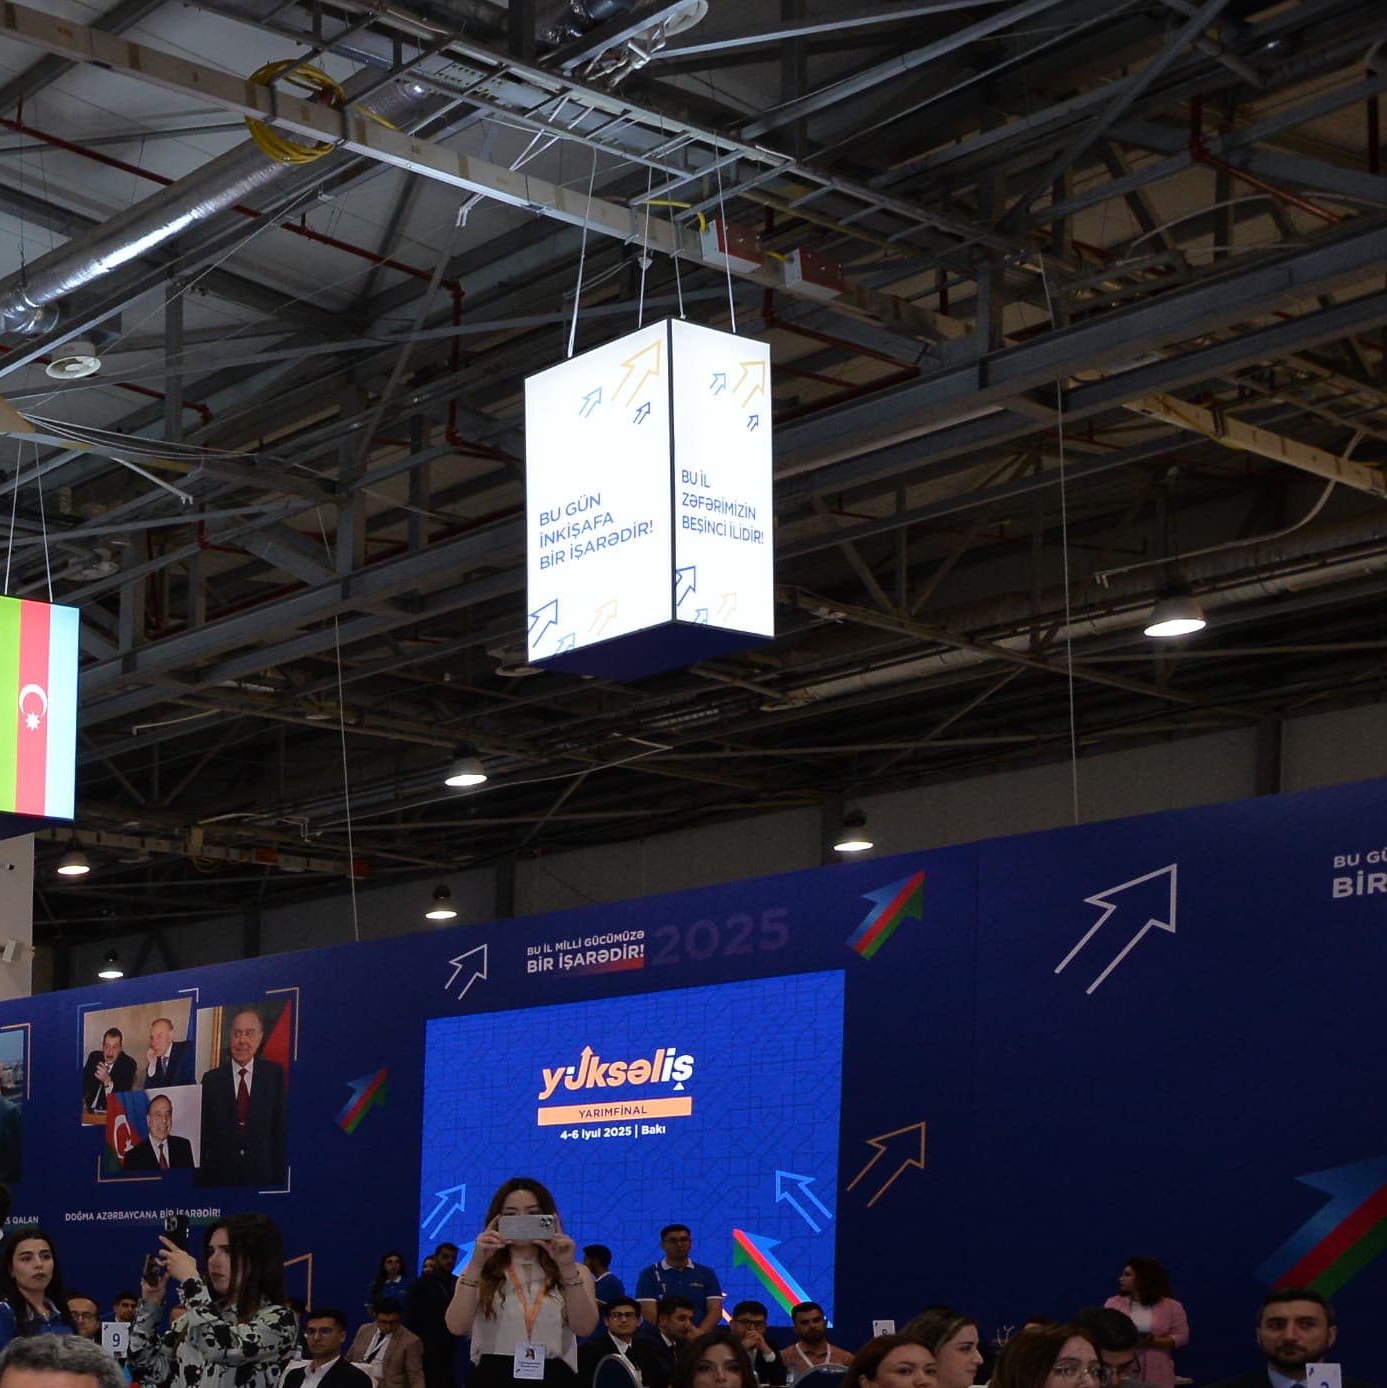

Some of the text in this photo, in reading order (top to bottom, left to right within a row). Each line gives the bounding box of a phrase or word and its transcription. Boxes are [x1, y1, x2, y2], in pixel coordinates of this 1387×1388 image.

[681, 469, 711, 489] BU İL
[539, 492, 602, 526] BU GÜN
[681, 492, 757, 521] ZƏFƏRİMİZİN
[539, 511, 615, 548] İNKİŞAFA
[681, 515, 765, 545] BEŞİNCİ İLİDİR!
[539, 520, 655, 570] BİR İŞARƏDİR!
[1333, 853, 1360, 868] BU
[1332, 870, 1387, 898] BİR
[527, 929, 645, 956] BU İL MİLLİ GÜCÜMÜZƏ
[651, 907, 789, 966] 2025
[527, 944, 645, 973] BİR İŞARƏDİR!
[538, 1045, 695, 1100] yüksəliş
[579, 1105, 648, 1119] YARIMFİNAL
[560, 1129, 579, 1140] 4-6
[603, 1126, 632, 1137] 2025
[12, 1216, 39, 1225] QALAN
[65, 1211, 94, 1221] DOĞMA
[96, 1209, 158, 1220] AZƏRBAYCANA
[112, 1333, 121, 1347] 9
